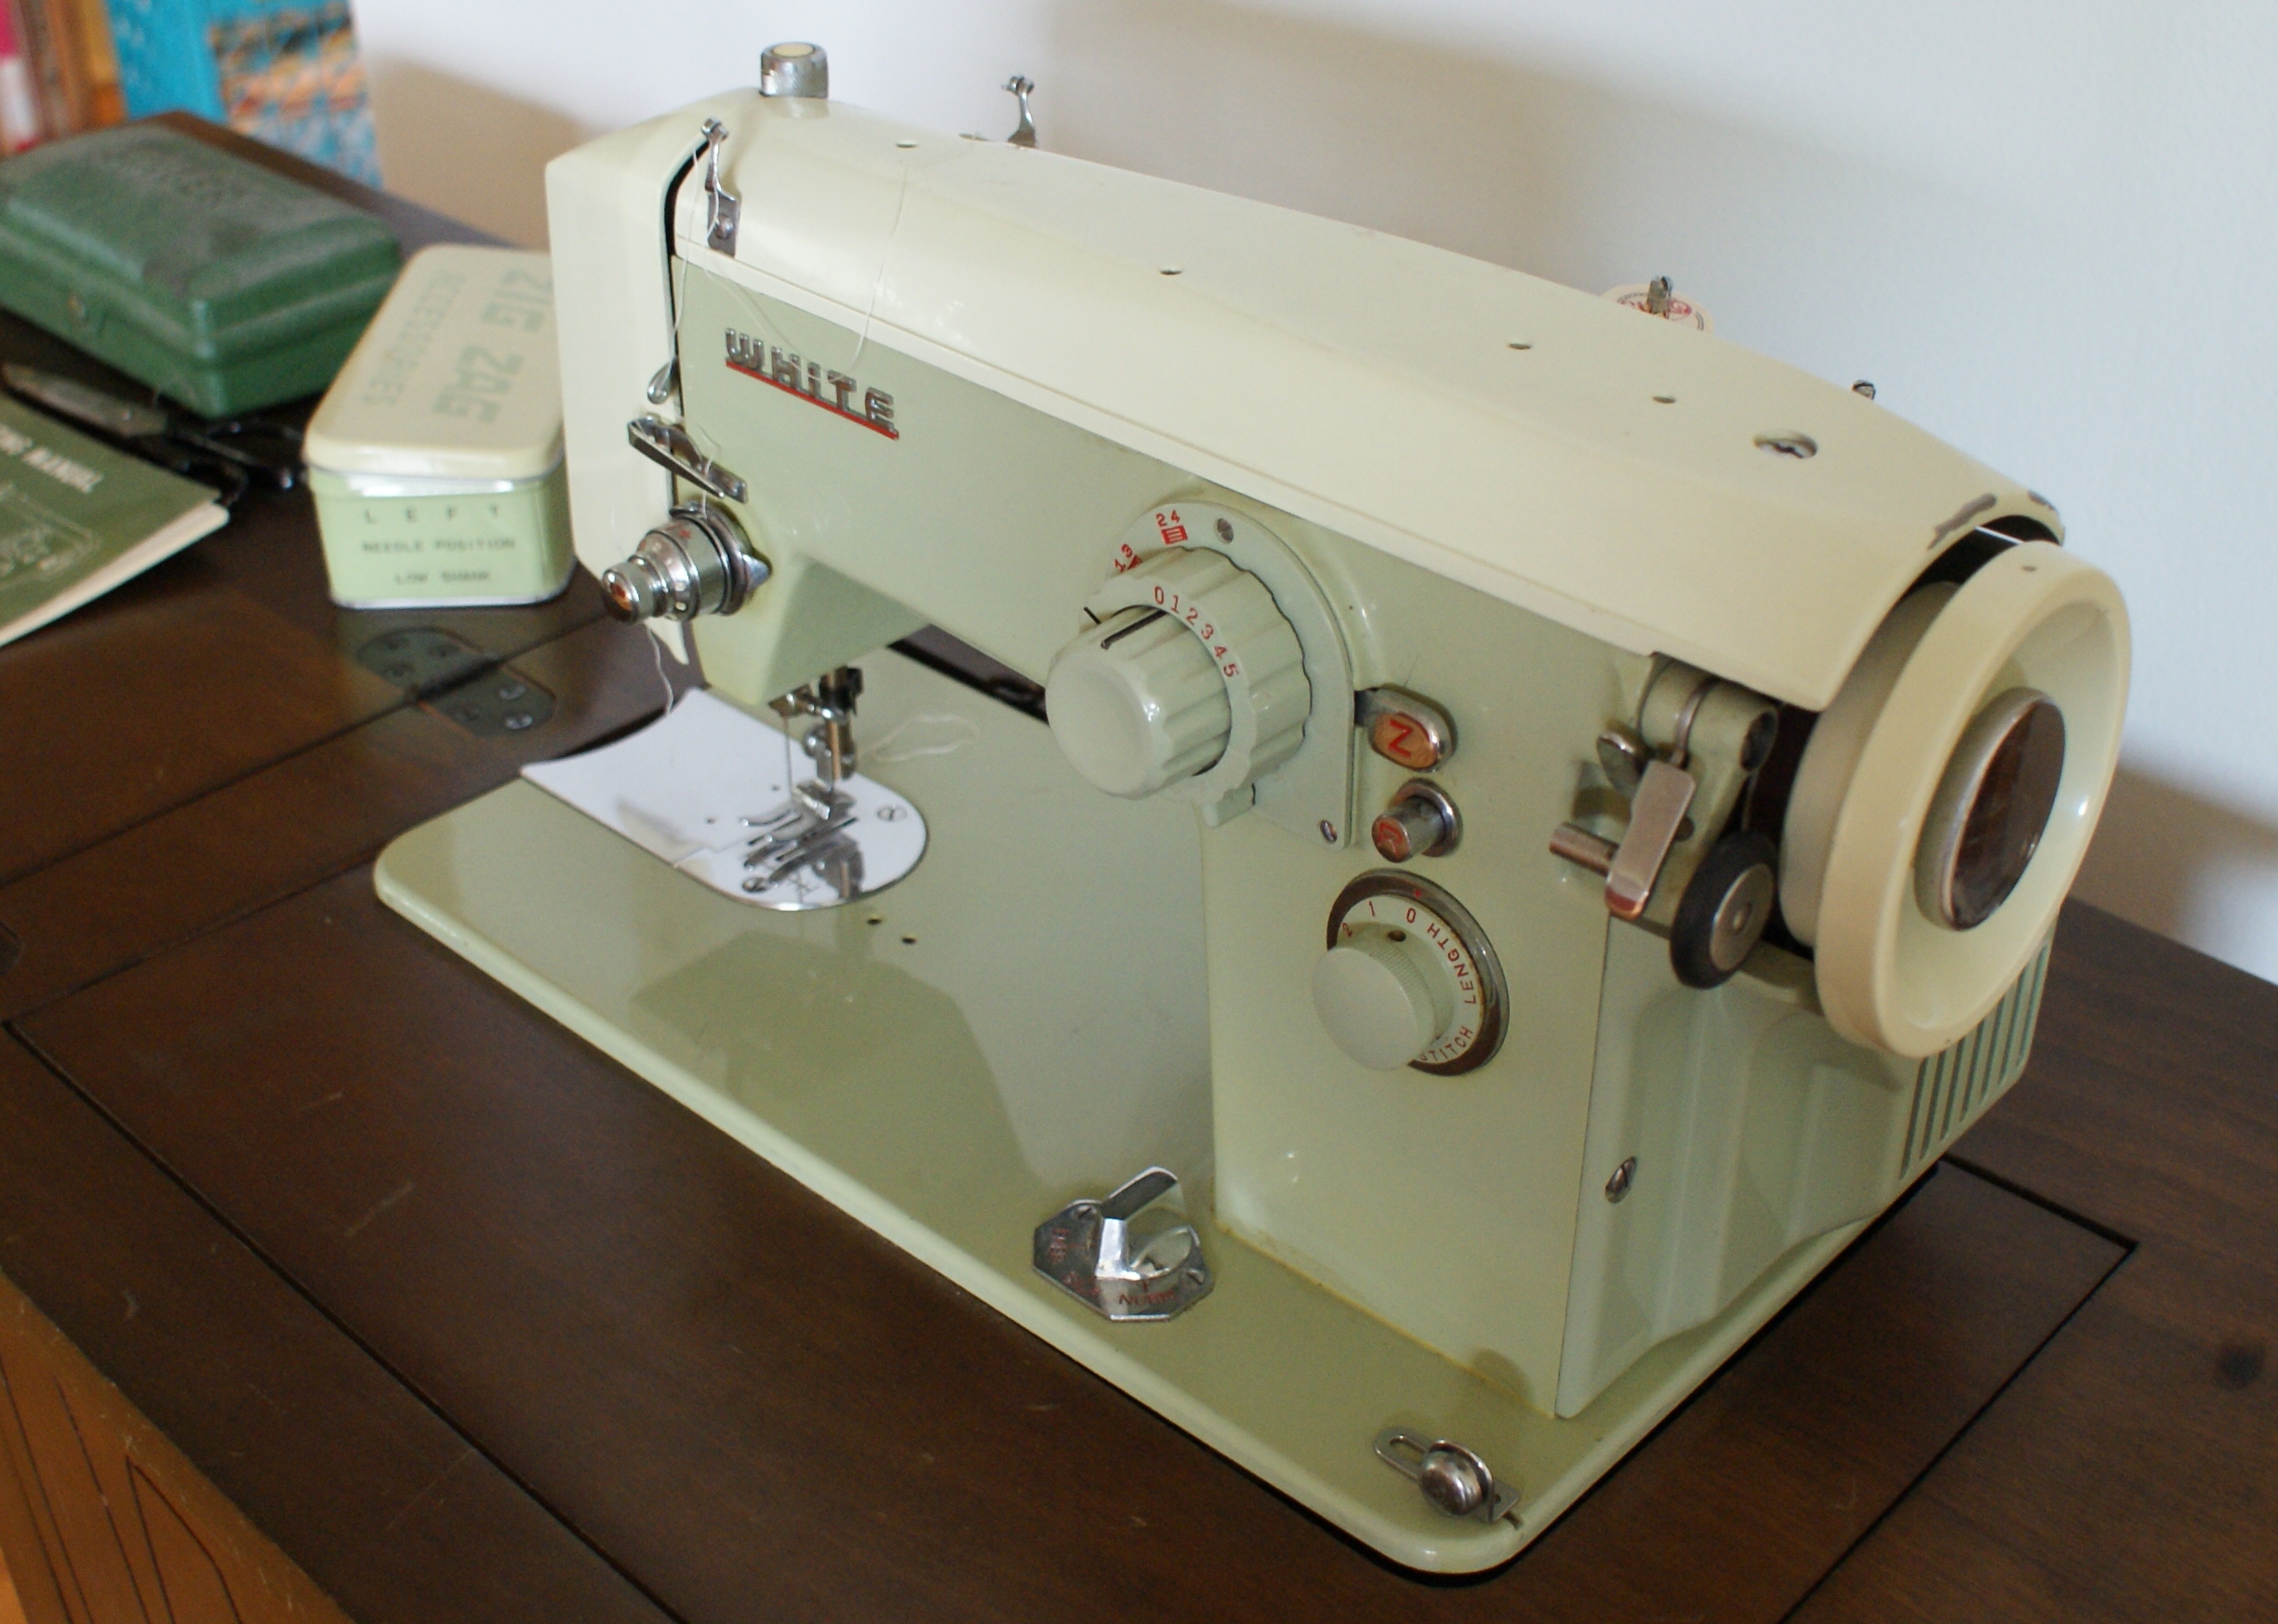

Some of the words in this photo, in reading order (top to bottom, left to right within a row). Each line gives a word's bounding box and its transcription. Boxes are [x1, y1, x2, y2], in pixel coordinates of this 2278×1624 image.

[725, 328, 895, 432] WHITE
[1388, 718, 1414, 759] Z
[1426, 922, 1477, 1005] LENGTH
